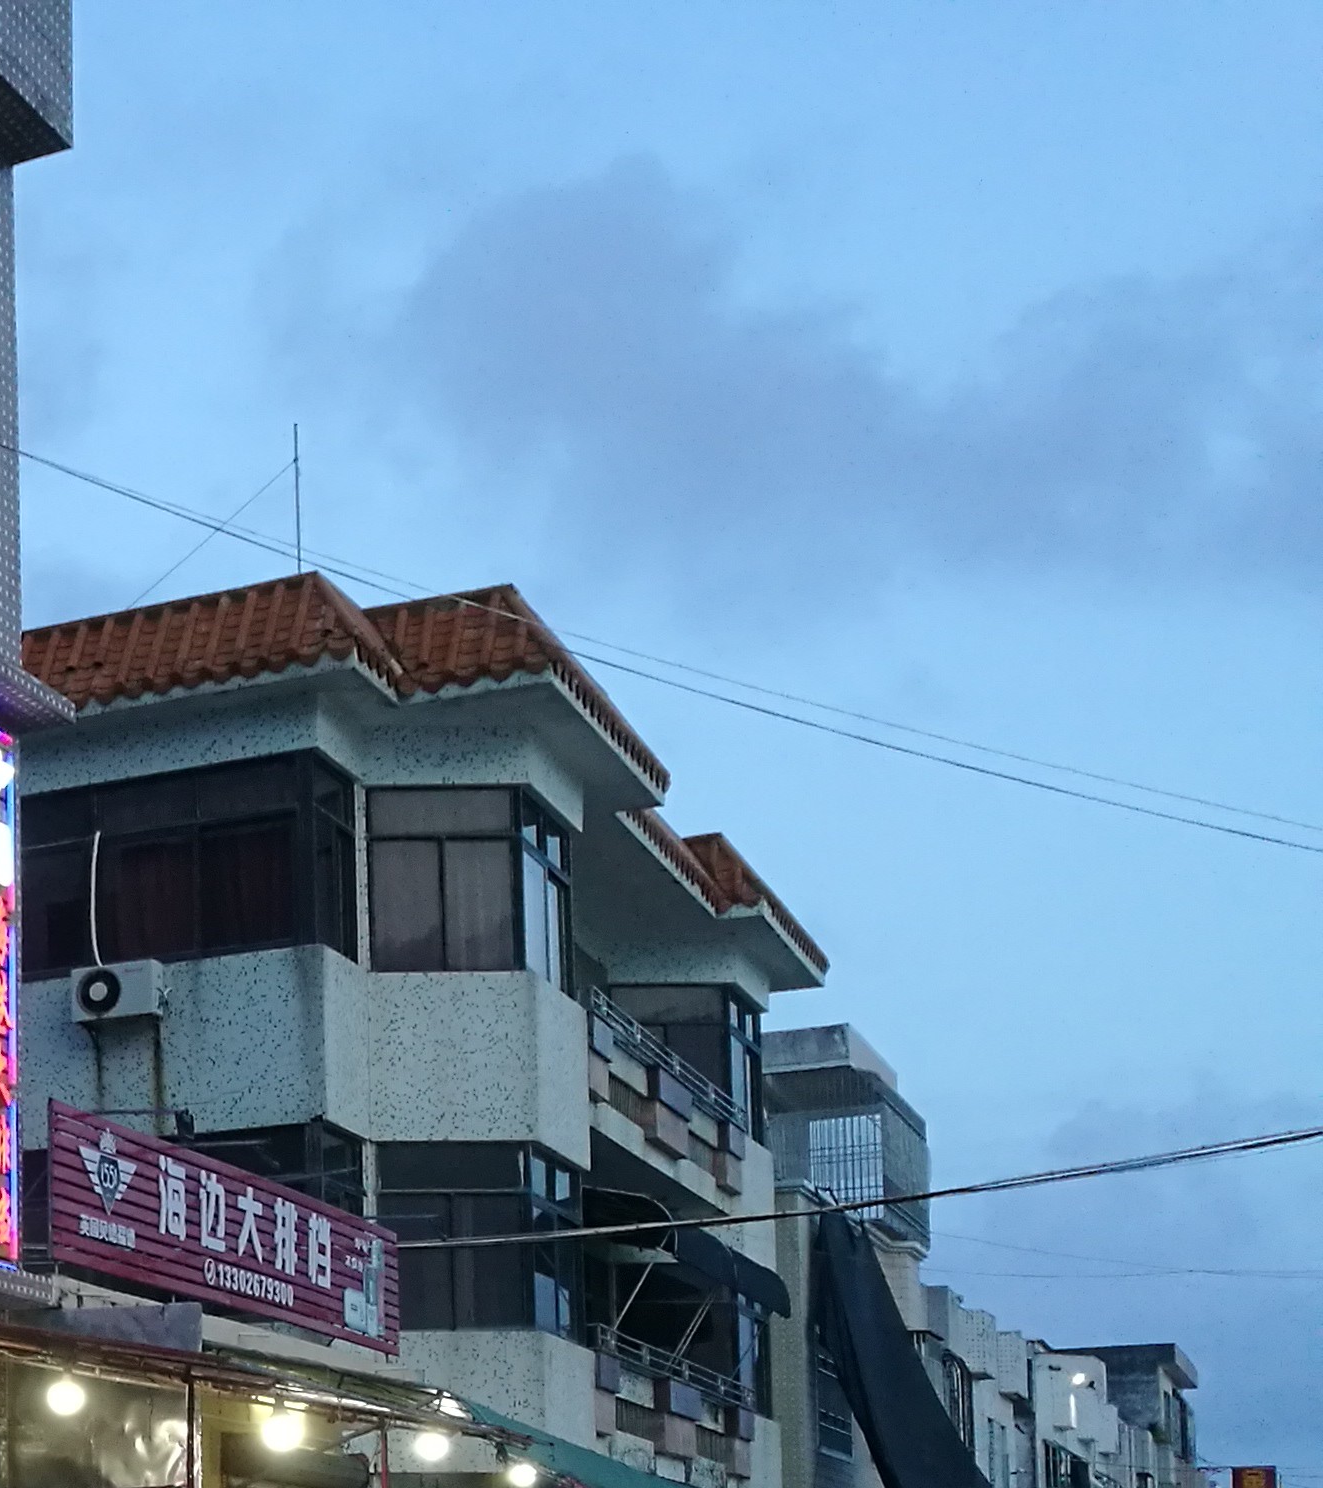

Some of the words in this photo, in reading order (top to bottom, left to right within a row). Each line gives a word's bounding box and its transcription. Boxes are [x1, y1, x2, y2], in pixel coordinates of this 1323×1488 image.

[157, 1154, 333, 1290] 海边大排档
[216, 1263, 295, 1308] 13302679300
